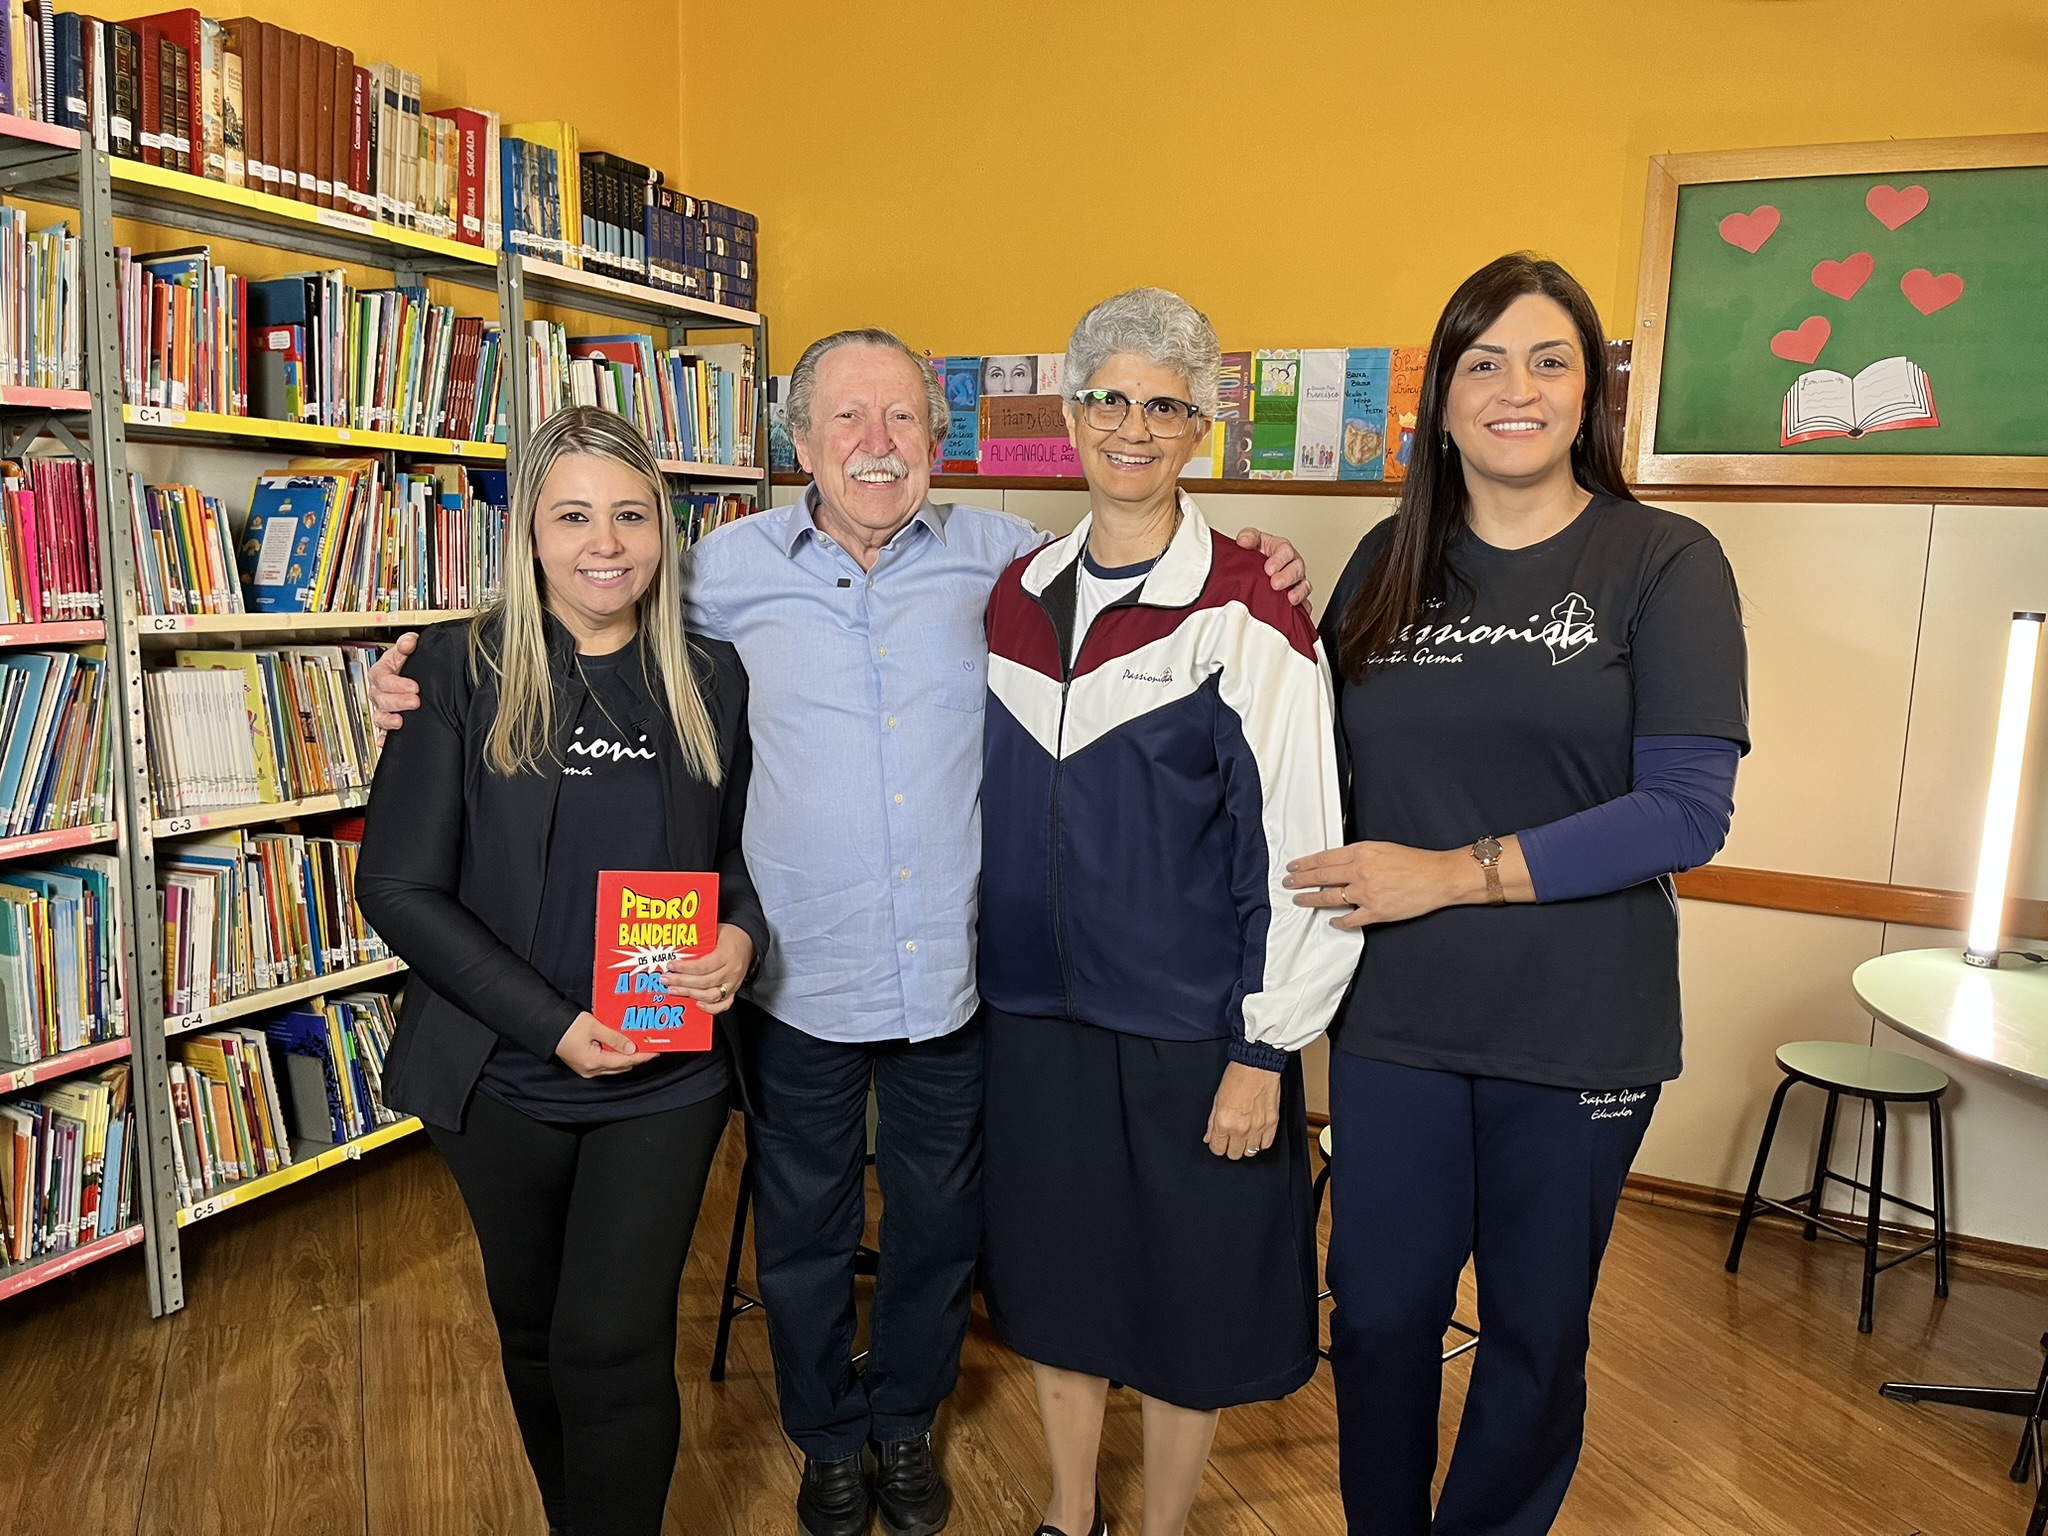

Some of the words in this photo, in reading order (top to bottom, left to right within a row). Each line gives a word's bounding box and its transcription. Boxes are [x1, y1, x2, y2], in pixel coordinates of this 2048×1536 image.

[193, 73, 202, 126] VATICANO
[466, 130, 475, 178] SAGRADA
[1306, 387, 1340, 399] Francisco
[140, 409, 161, 423] C-1
[990, 444, 1058, 462] ALMANAQUE
[154, 618, 177, 631] C-2
[1412, 647, 1464, 666] Gema
[170, 819, 192, 833] C-3
[620, 886, 700, 921] PEDRO
[618, 923, 699, 947] BANDEIRA
[638, 956, 648, 966] OS
[652, 952, 677, 964] KARAS
[614, 972, 631, 994] A
[181, 1014, 203, 1029] C-4
[621, 1005, 686, 1031] AMOR
[1578, 1091, 1618, 1106] Santa
[1618, 1089, 1647, 1104] Gema
[1590, 1106, 1634, 1120] Educador
[193, 1202, 215, 1220] C-5
